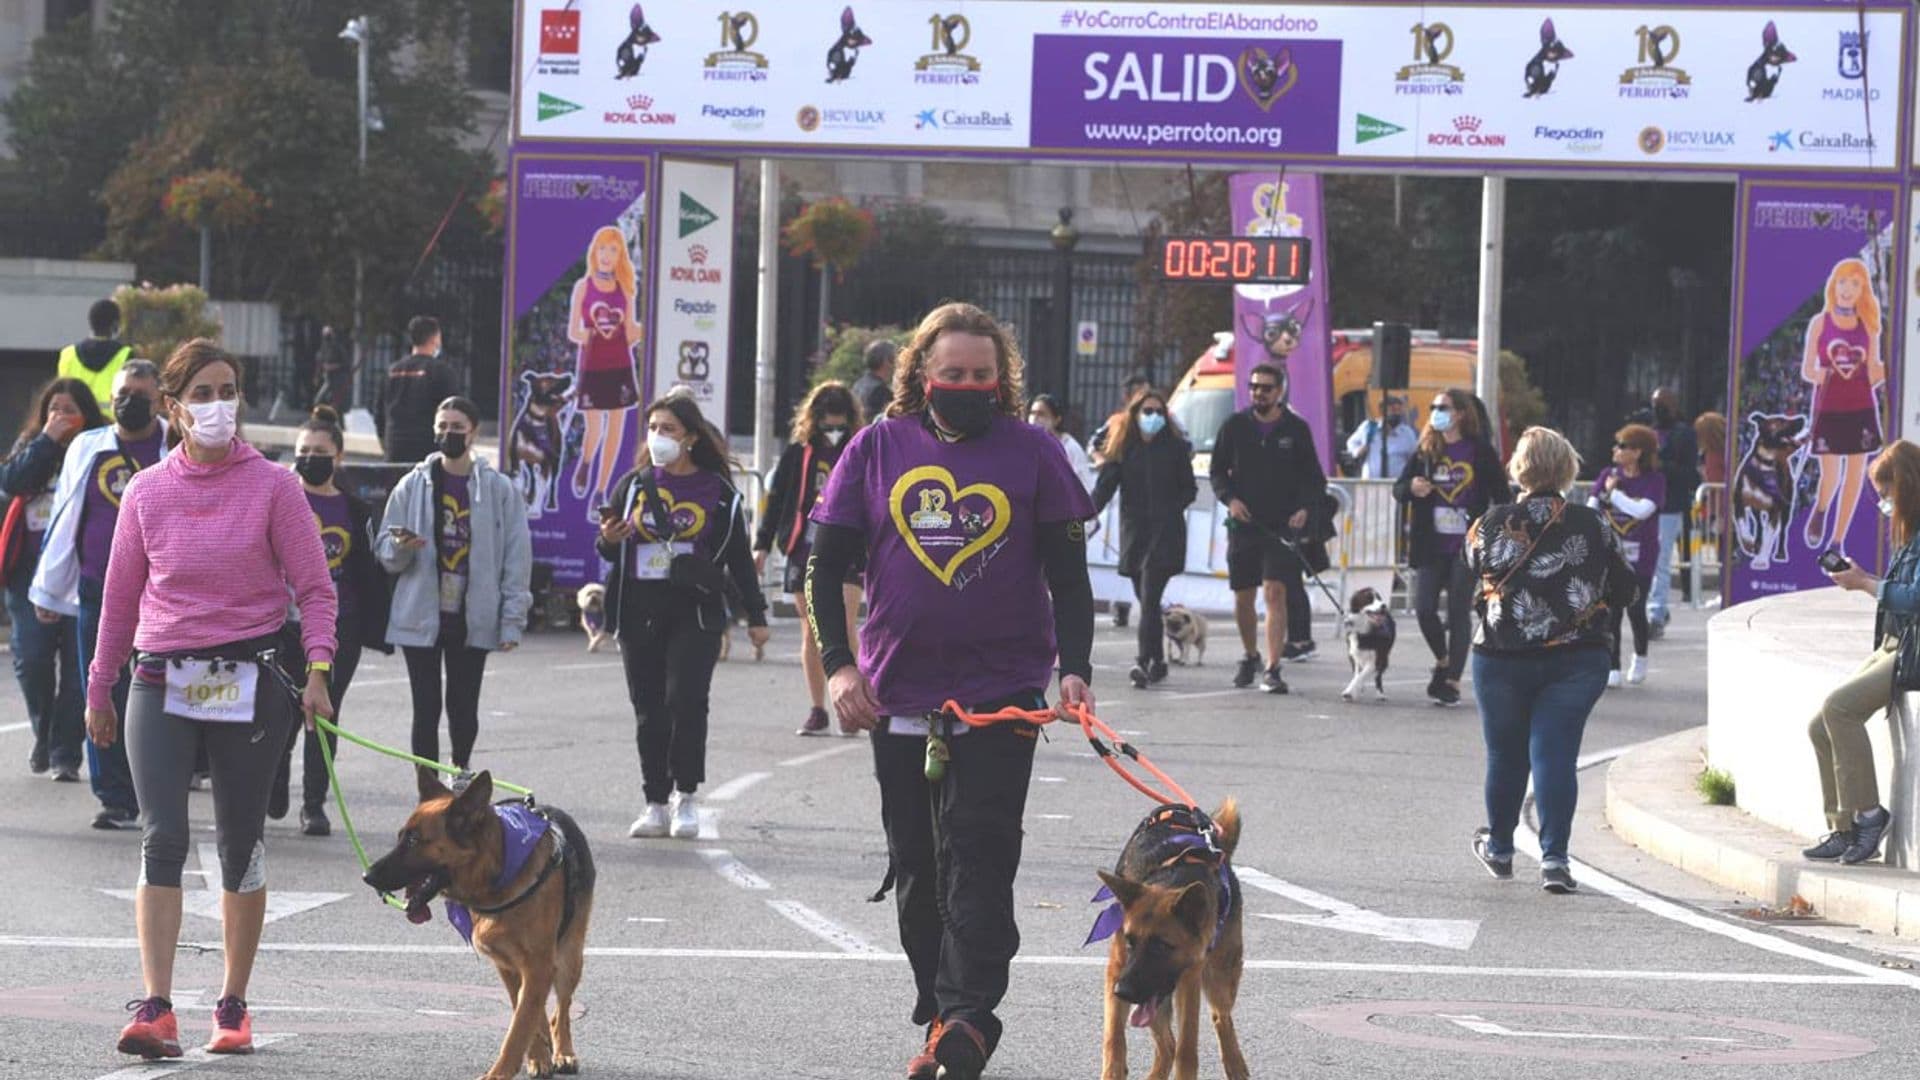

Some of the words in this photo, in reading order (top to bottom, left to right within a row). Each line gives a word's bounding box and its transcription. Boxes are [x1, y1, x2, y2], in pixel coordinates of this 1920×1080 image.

[1060, 9, 1319, 33] #YoCorroContraElAbandono
[1083, 51, 1237, 103] SALID
[1822, 88, 1880, 101] MADRD
[604, 112, 638, 124] ROYAL
[640, 113, 676, 125] CANIN
[942, 110, 1013, 127] CaixaBank
[1085, 122, 1282, 147] www.perroton.org
[1428, 133, 1465, 145] ROYAL
[1467, 134, 1505, 147] CANIN
[1534, 126, 1604, 140] Flexodin
[1799, 131, 1877, 149] CaixaBank
[1164, 239, 1298, 277] 00:20:11
[183, 683, 241, 702] 1010
